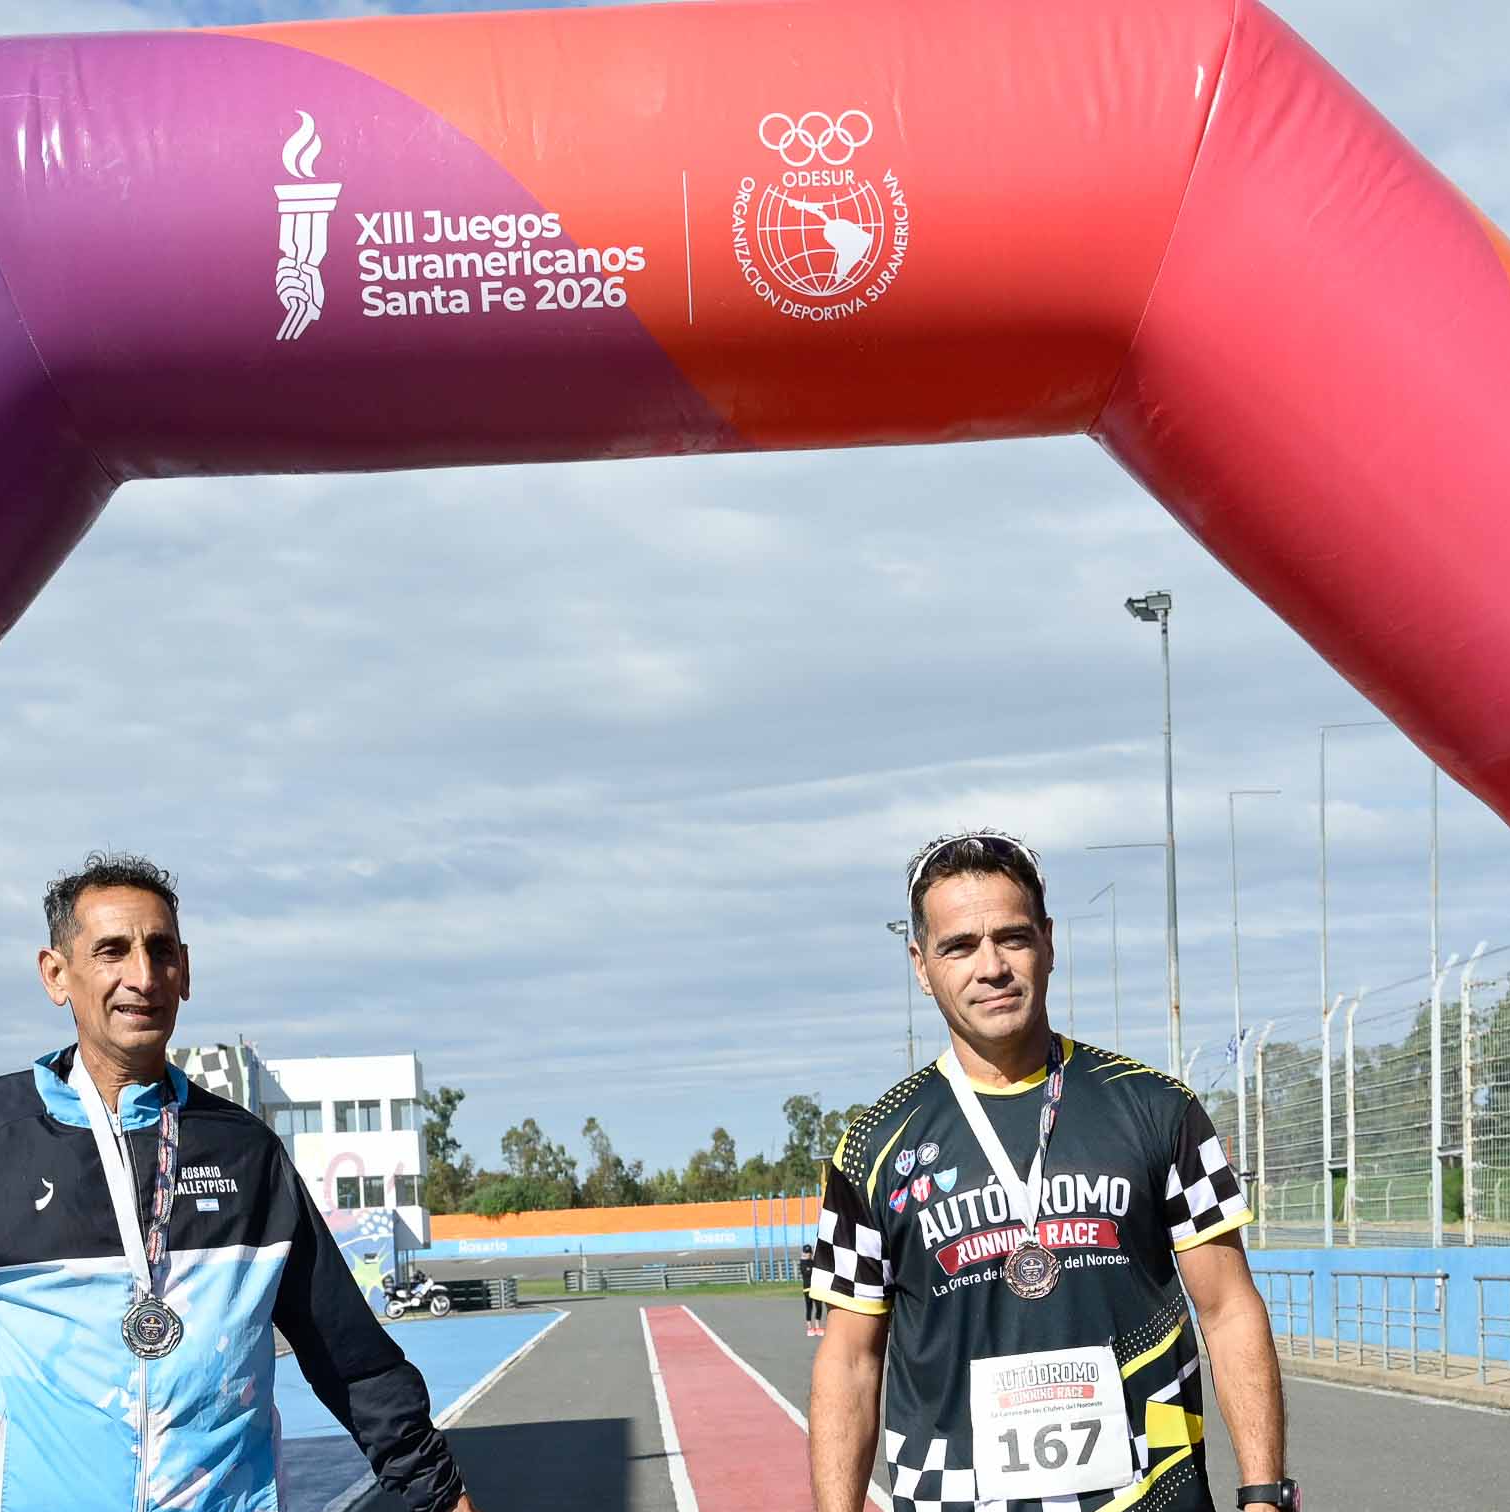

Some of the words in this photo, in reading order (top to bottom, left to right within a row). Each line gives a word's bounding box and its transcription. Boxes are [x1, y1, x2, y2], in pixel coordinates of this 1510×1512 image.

[782, 170, 855, 187] ODESUR
[355, 211, 415, 246] XIII
[423, 210, 562, 249] Juegos
[732, 176, 781, 307] ORGANIZACION
[865, 169, 908, 302] SURAMERICANA
[358, 240, 646, 282] Suramericanos
[361, 285, 470, 317] Santa
[480, 281, 526, 312] Fe
[533, 276, 627, 310] 2026
[780, 297, 868, 321] DEPORTIVA
[175, 1179, 238, 1195] ALLEYPISTA
[181, 1166, 221, 1179] ROSARIO
[917, 1174, 1131, 1250] AUTÓROMO
[1046, 1222, 1099, 1246] RACE
[932, 1282, 948, 1297] La
[984, 1268, 997, 1281] de
[1064, 1254, 1083, 1269] del
[998, 1419, 1102, 1472] 167
